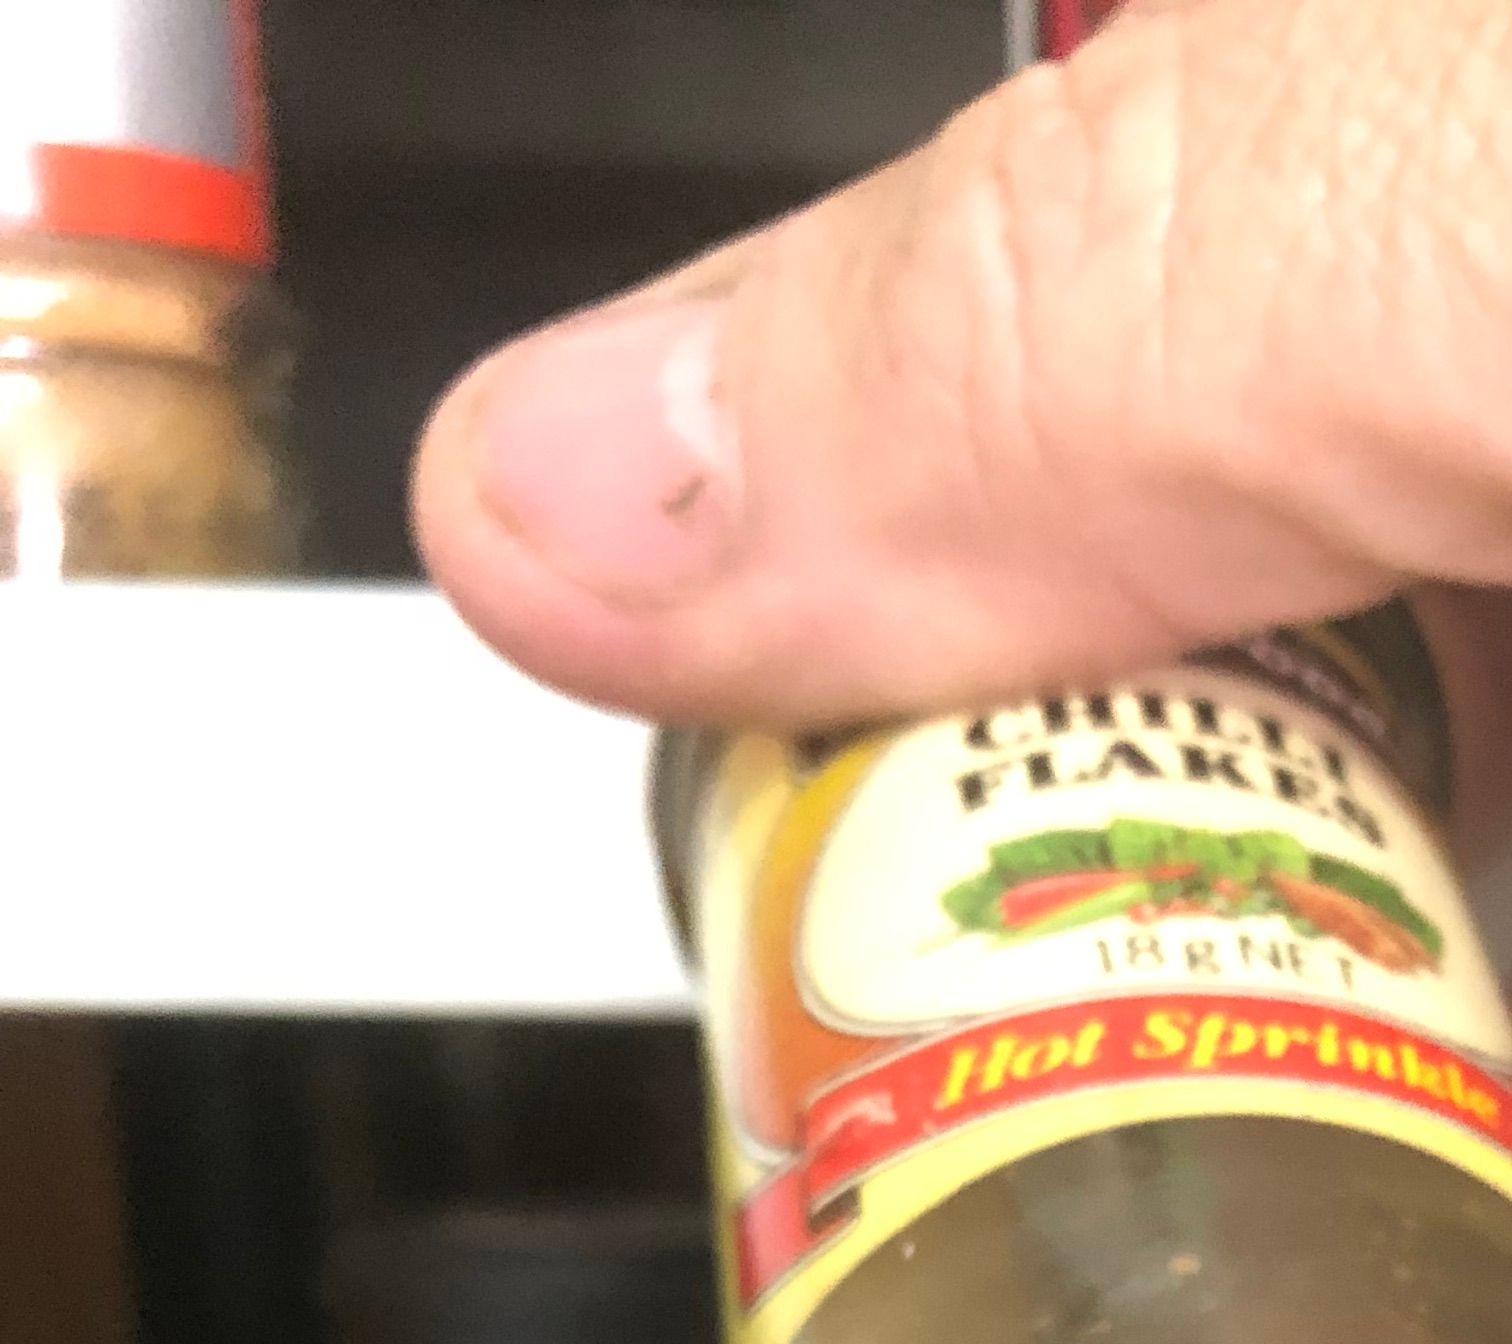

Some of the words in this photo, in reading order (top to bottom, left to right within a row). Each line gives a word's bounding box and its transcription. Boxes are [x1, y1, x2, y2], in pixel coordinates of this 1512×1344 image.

[954, 735, 1388, 850] FLAKES
[932, 1016, 1108, 1112] Hot
[1130, 1008, 1502, 1130] Sprinkle
